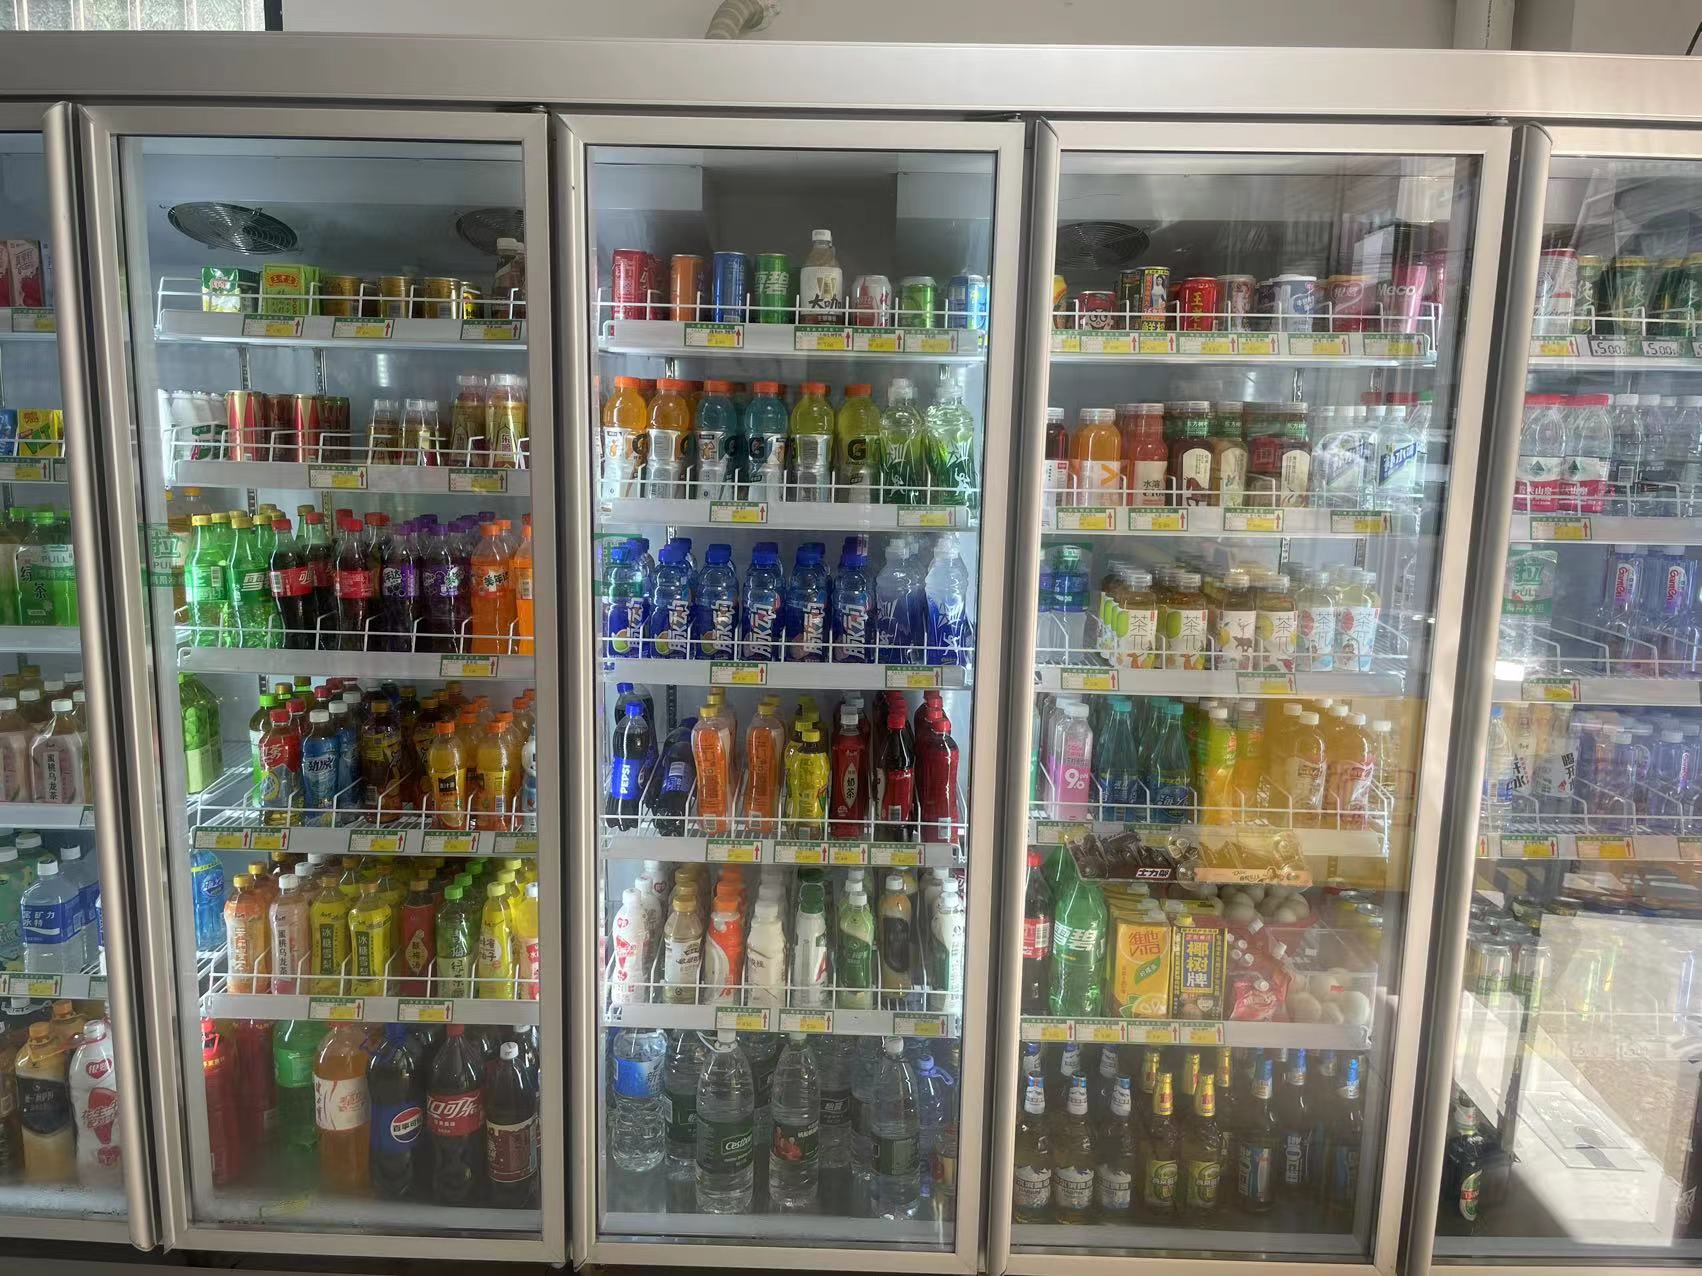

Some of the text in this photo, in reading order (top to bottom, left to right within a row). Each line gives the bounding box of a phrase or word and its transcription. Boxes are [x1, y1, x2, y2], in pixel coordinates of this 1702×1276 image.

[1143, 480, 1160, 488] 水溶
[47, 754, 58, 800] 蜜桃乌龙茶
[620, 764, 631, 794] PEPSI
[846, 777, 856, 799] 奶茶
[278, 929, 290, 975] 蜜桃乌龙茶
[322, 927, 333, 974] 冰糖雪梨
[358, 933, 369, 977] 冰糖雪梨
[1186, 942, 1208, 988] 椰树牌
